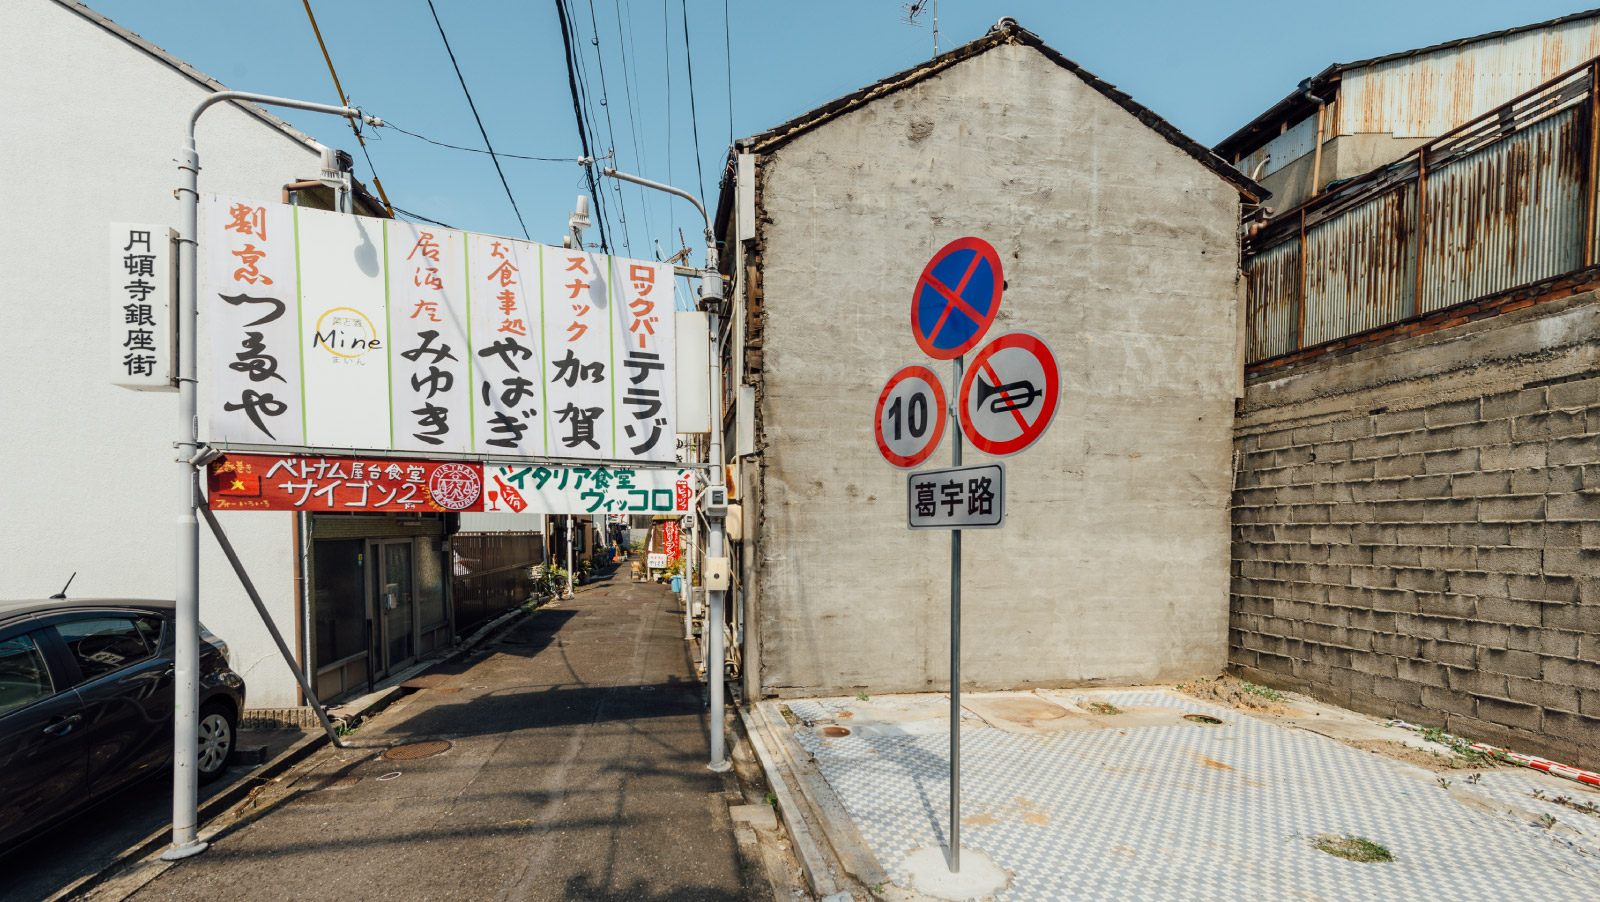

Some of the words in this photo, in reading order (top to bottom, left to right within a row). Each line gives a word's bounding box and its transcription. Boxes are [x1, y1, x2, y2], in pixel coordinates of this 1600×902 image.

[225, 203, 273, 285] 割烹
[123, 230, 157, 377] 円頓寺銀座街
[487, 241, 527, 336] お食事処
[566, 257, 590, 342] スナック
[629, 264, 659, 348] ロックバー
[313, 329, 383, 350] Mine
[400, 329, 459, 445] みゆき
[477, 336, 537, 449] やはぎ
[551, 348, 605, 450] 加賀
[623, 350, 667, 455] テラゾ
[888, 392, 928, 440] 10
[266, 457, 426, 484] ベトナム屋台食堂
[278, 479, 425, 508] サイゴン2
[434, 464, 477, 480] VIETNAM
[507, 465, 636, 490] イタリア食堂
[580, 488, 674, 513] ヴィッコロ
[914, 476, 995, 517] 葛宇路
